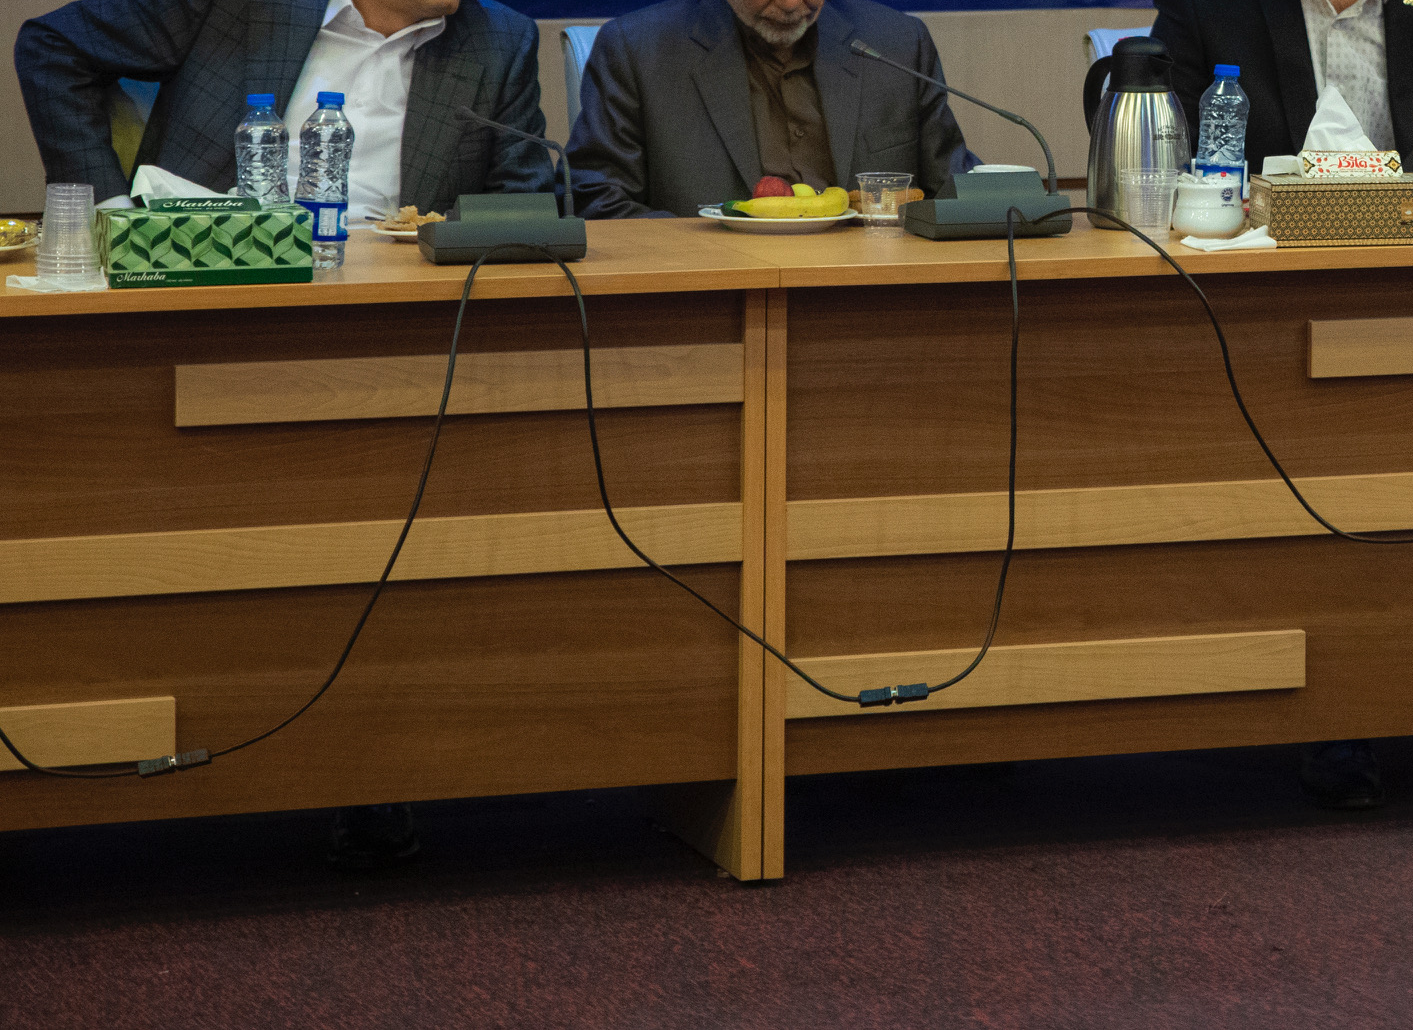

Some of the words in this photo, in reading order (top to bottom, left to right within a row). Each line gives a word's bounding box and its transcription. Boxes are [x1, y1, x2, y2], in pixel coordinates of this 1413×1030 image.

[1337, 155, 1368, 169] Bita
[162, 200, 244, 208] Marhaba
[116, 271, 167, 282] Marhaba
